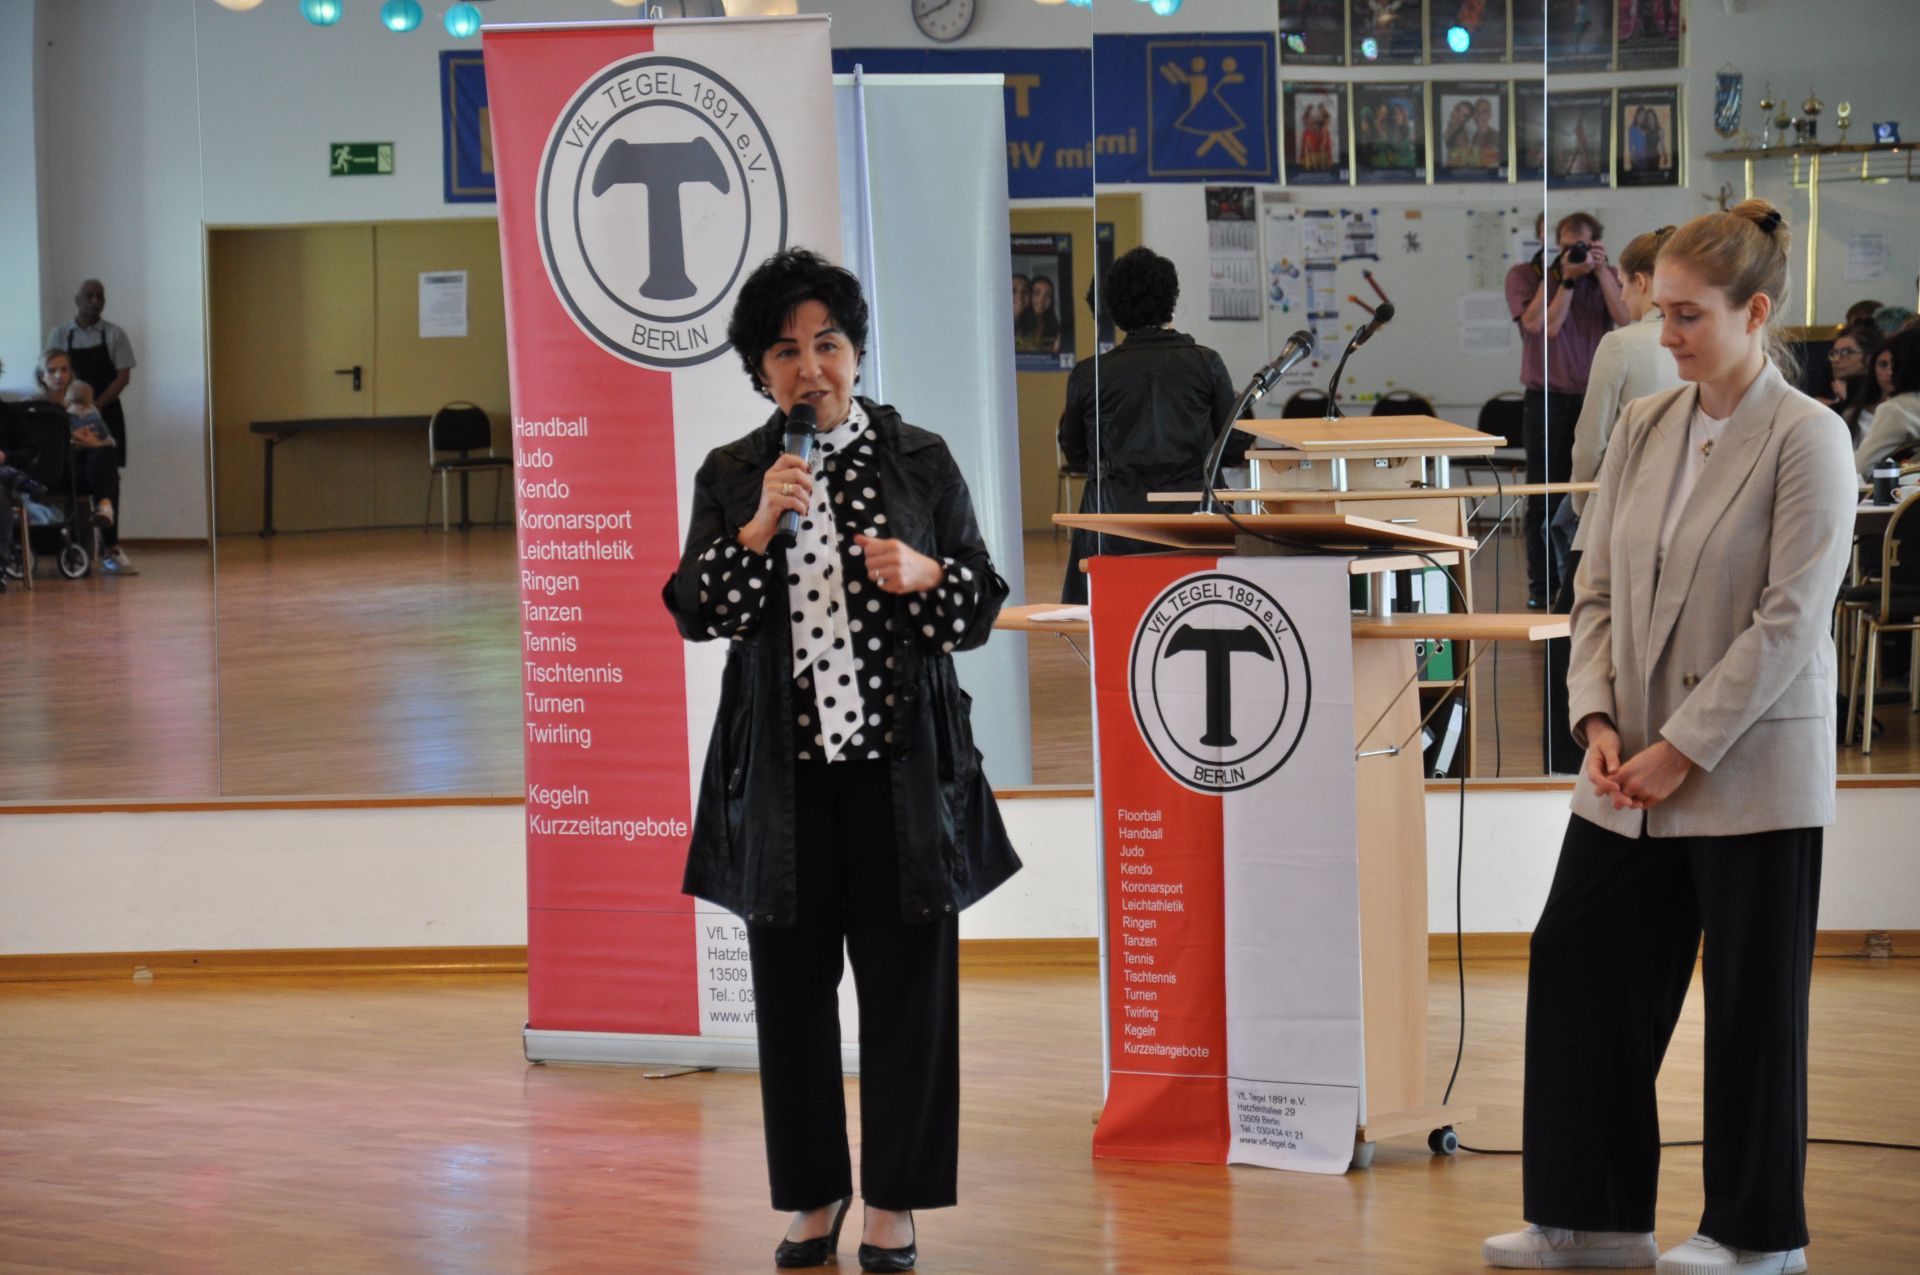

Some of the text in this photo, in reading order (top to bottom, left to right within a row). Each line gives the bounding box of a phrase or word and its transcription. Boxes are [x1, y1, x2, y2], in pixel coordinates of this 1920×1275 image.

[565, 72, 767, 184] VfL TEGEL 1891 e.V.
[631, 323, 709, 352] BERLIN
[514, 416, 588, 437] Handball
[516, 448, 553, 468] Judo
[517, 478, 570, 499] Kendo
[519, 509, 632, 534] Koronarsport
[520, 540, 634, 560] Leichtathletik
[521, 570, 579, 596] Ringen
[522, 600, 582, 621] Tanzen
[1148, 610, 1173, 635] VfL
[1168, 583, 1222, 612] TEGEL
[1227, 585, 1263, 612] 1891
[524, 631, 577, 652] Tennis
[525, 662, 623, 683] Tischtennis
[526, 692, 585, 713] Turnen
[527, 722, 592, 749] Twirling
[1193, 765, 1246, 785] BERLIN
[529, 784, 589, 809] Kegeln
[1117, 809, 1162, 822] Floorball
[529, 814, 688, 841] Kurzzeitangebote
[1119, 827, 1163, 840] Handball
[1120, 845, 1145, 857] Judo
[1120, 863, 1153, 875] Kendo
[1121, 880, 1184, 896] Koronarsport
[1122, 898, 1184, 912] Leichtathletik
[1122, 916, 1157, 932] Ringen
[706, 926, 728, 940] VfL
[1123, 934, 1157, 947] Tanzen
[1123, 951, 1155, 965] Tennis
[709, 968, 748, 982] 13509
[1124, 969, 1176, 984] Tischtennis
[709, 988, 735, 1002] Tel.:
[1124, 987, 1157, 1001] Turnen
[1124, 1005, 1159, 1021] Twirling
[1124, 1023, 1156, 1039] Kegeln
[1124, 1041, 1210, 1059] Kurzzeitangebote
[1248, 1093, 1266, 1103] Tegel
[1268, 1095, 1288, 1105] 1891
[1290, 1097, 1307, 1106] e.V.
[1238, 1114, 1281, 1126] 13509 Berlin
[1284, 1107, 1296, 1117] 29
[1284, 1130, 1293, 1139] 41
[1294, 1130, 1304, 1140] 21
